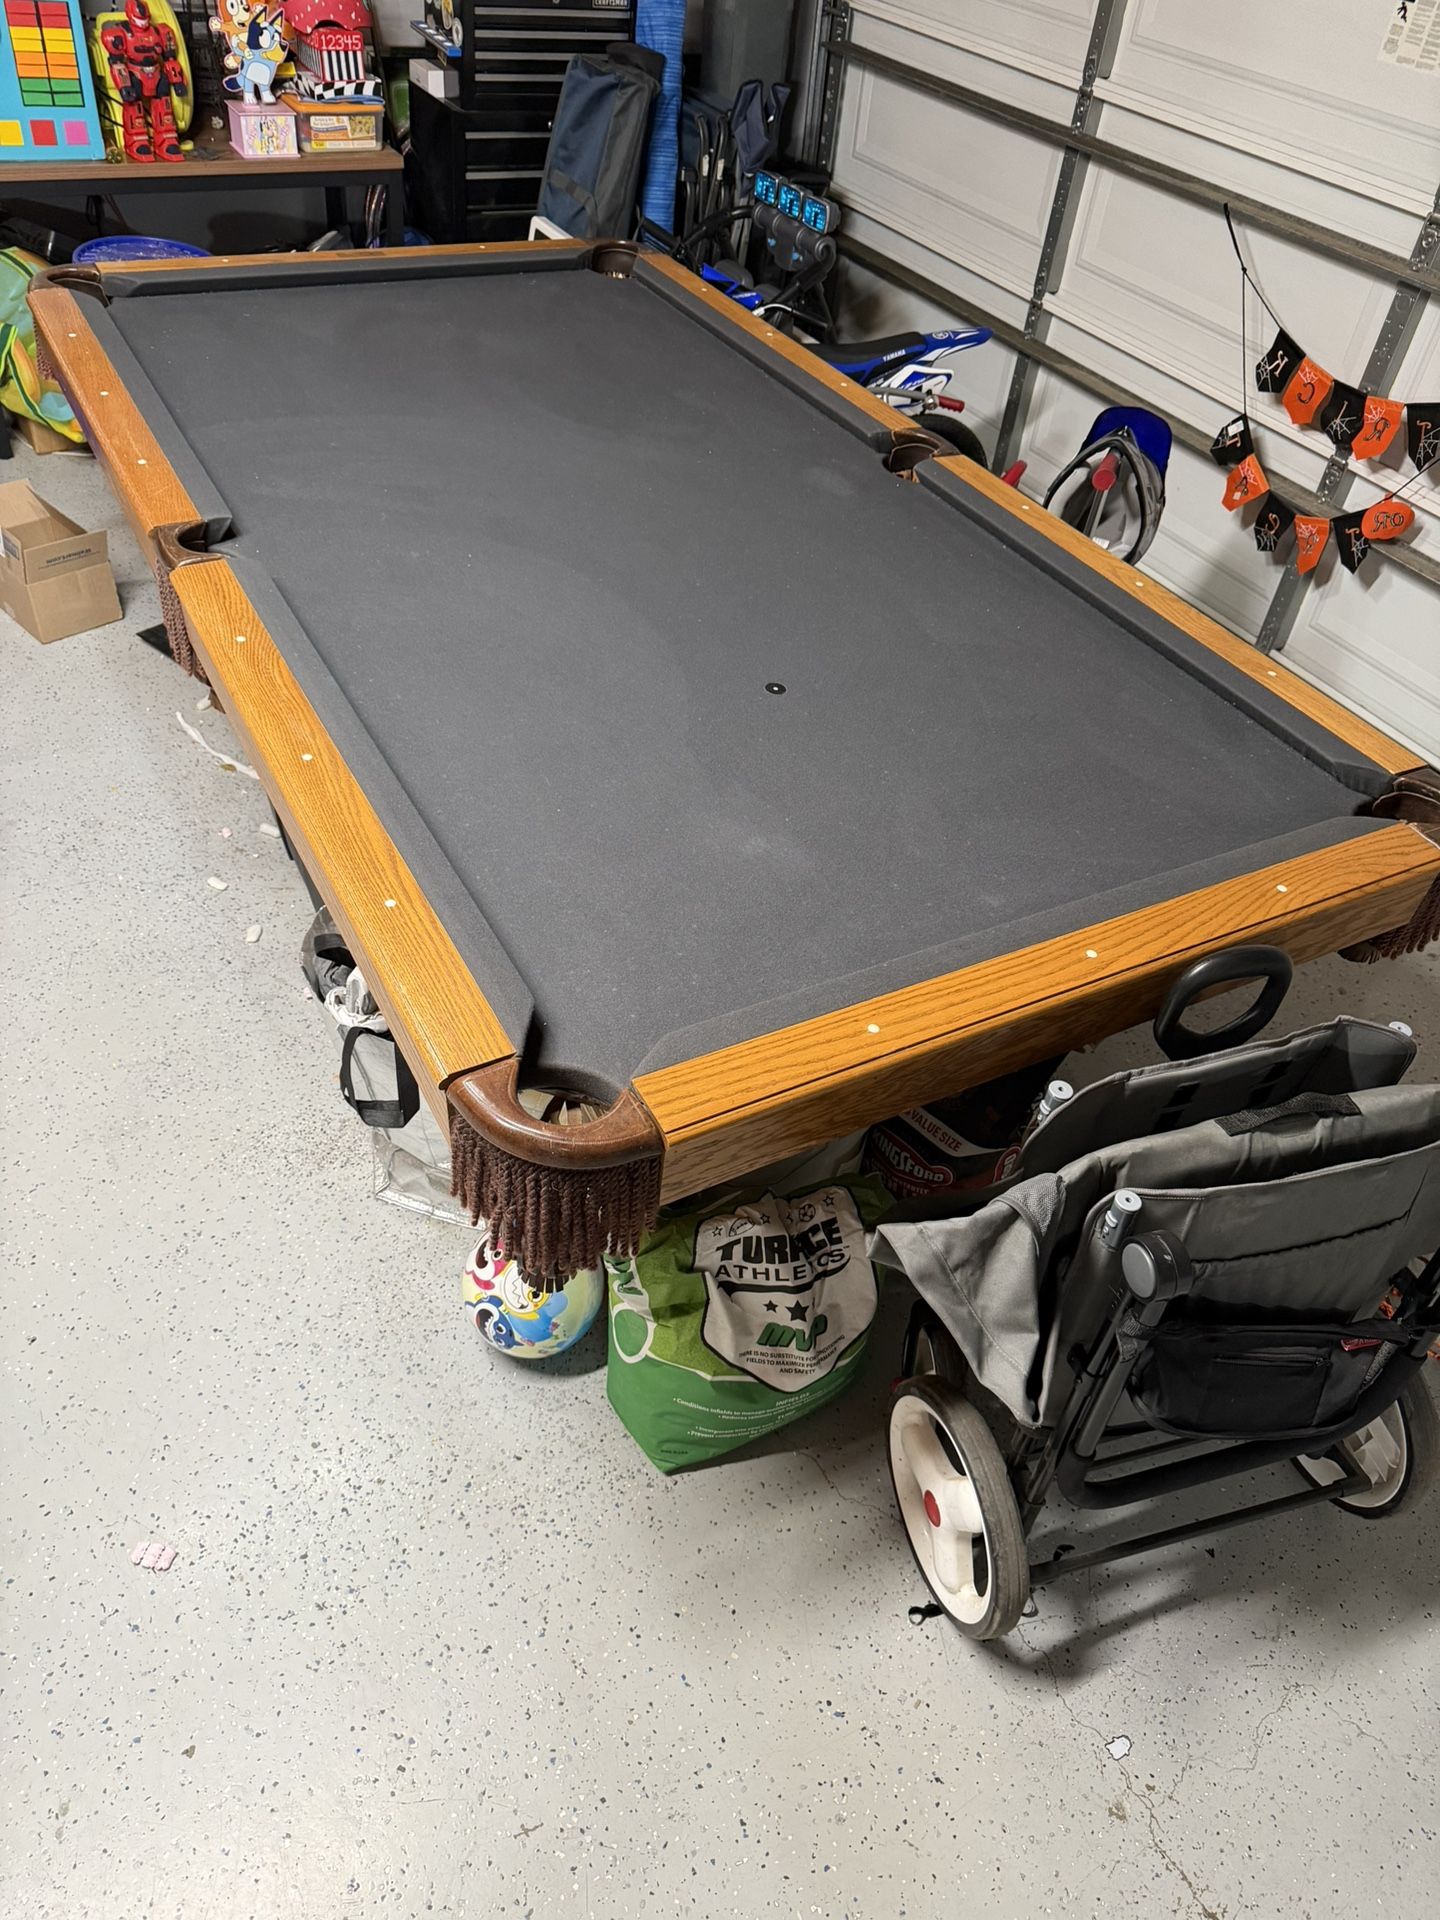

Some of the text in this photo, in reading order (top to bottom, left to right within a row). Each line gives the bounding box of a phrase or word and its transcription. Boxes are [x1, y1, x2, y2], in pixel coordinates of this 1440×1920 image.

[320, 34, 362, 50] 12345
[882, 349, 907, 363] YAMAHA
[910, 1109, 963, 1153] VALUE SIZE
[872, 1132, 945, 1183] KINGSFORD
[746, 1357, 766, 1365] FIELDS
[775, 1360, 805, 1368] MAXIMIZE
[769, 1352, 805, 1361] SUBSTITUTE
[794, 1367, 816, 1375] SAFETY
